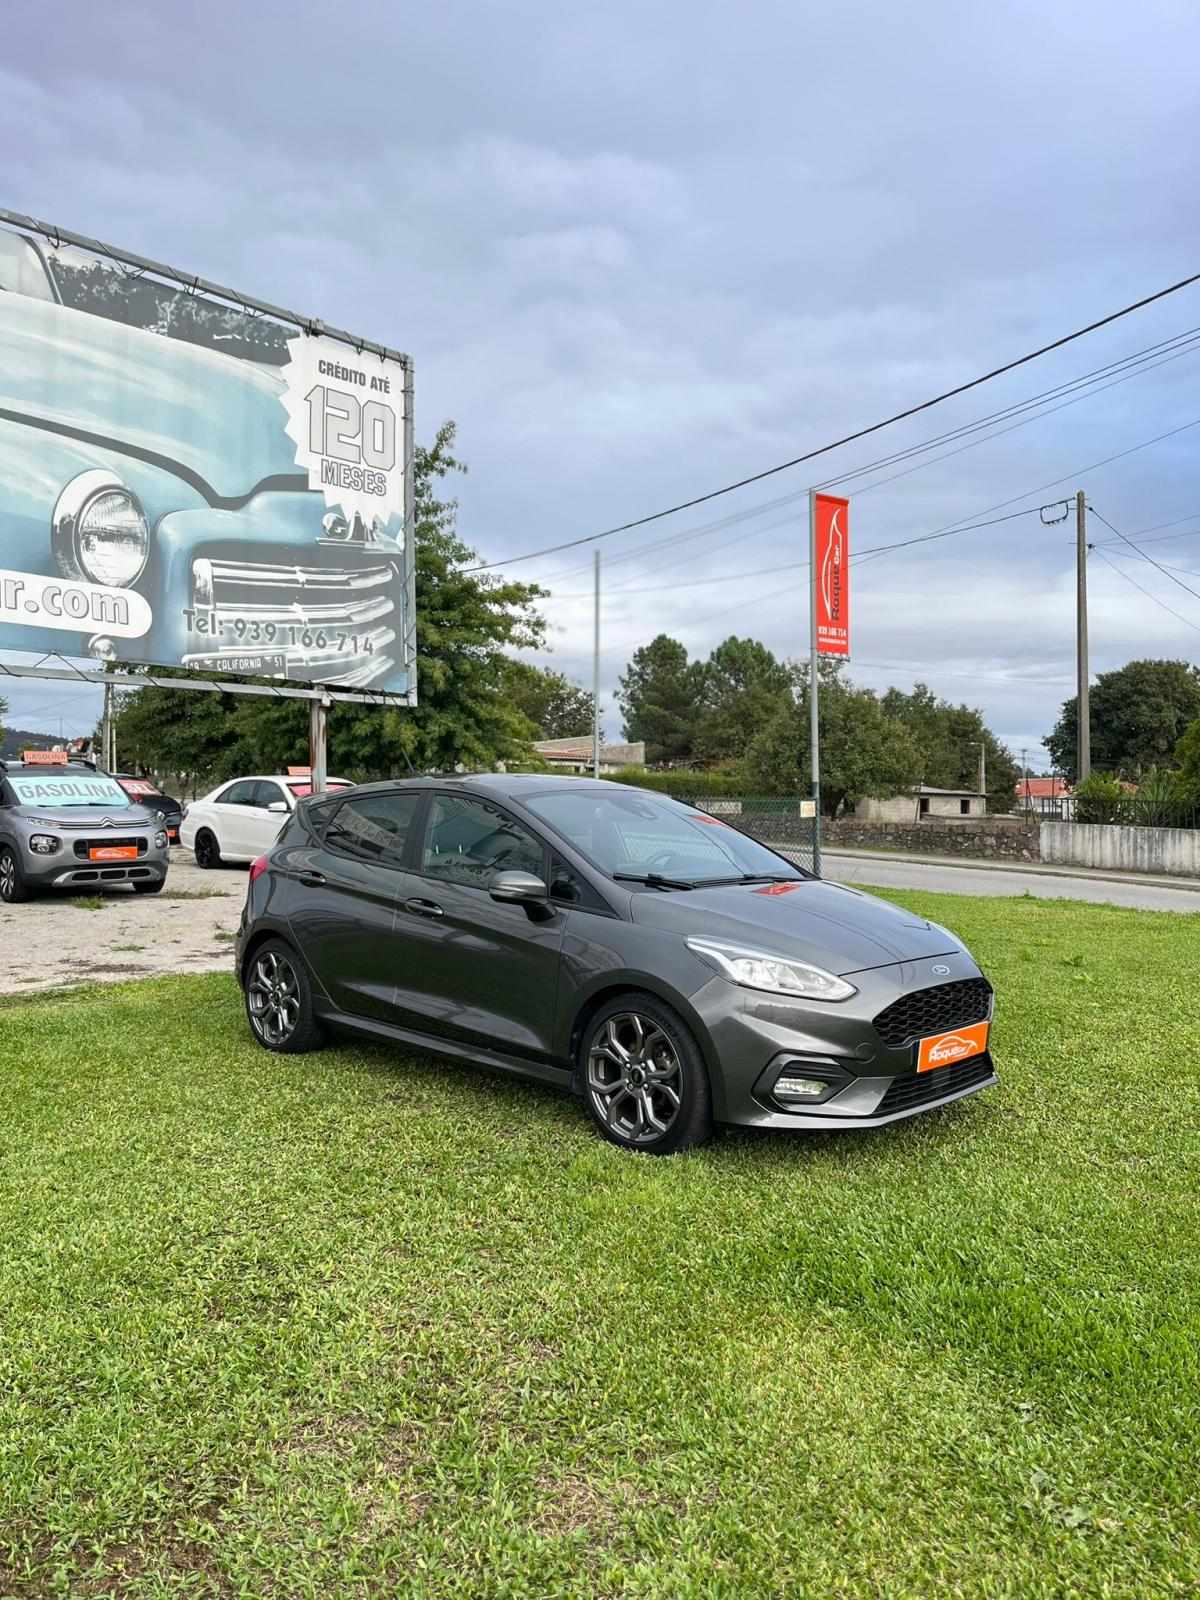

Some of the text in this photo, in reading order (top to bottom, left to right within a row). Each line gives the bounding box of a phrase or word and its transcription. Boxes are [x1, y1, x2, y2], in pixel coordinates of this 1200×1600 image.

[318, 359, 391, 394] CRÉDITO ATÉ
[304, 384, 396, 472] 120
[321, 459, 387, 496] MESES
[0, 579, 129, 625] r.com
[182, 609, 374, 656] Tel: 939 166 714
[216, 656, 262, 671] CALIFORNIA
[20, 783, 121, 799] GASOLINA
